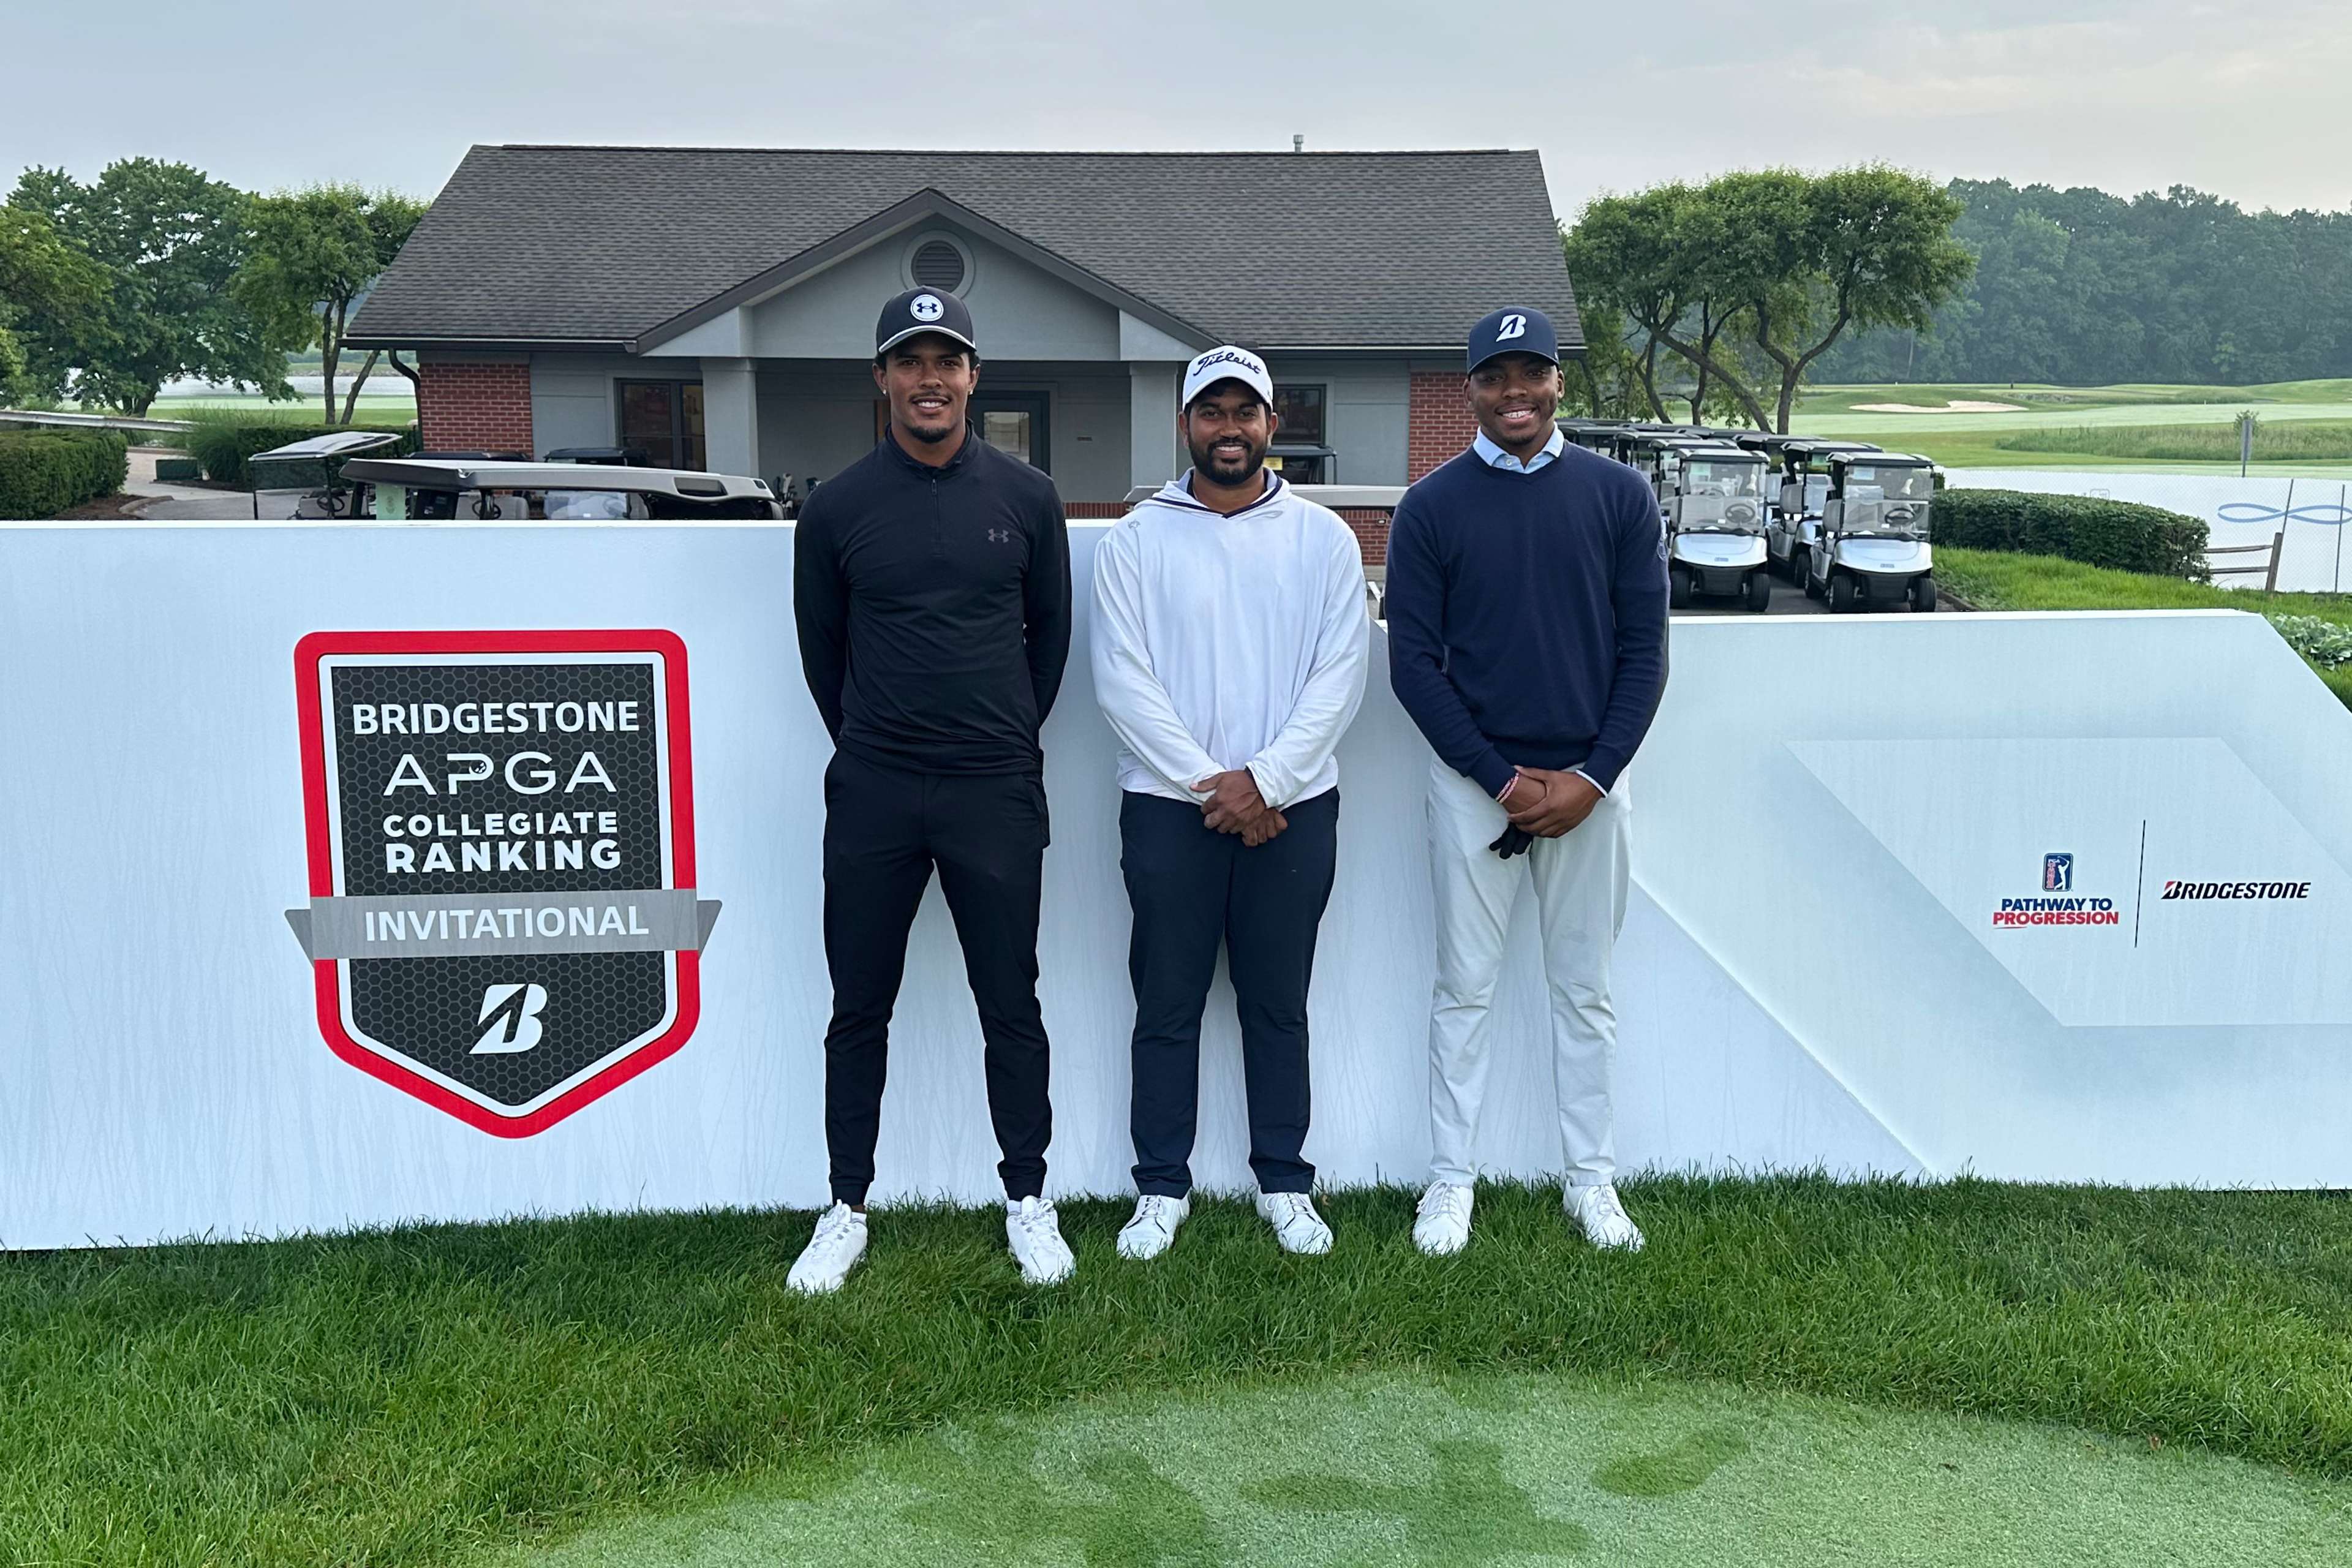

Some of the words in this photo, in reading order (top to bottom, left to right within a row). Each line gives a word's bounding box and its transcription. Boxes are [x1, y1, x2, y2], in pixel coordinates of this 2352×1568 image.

[1193, 351, 1261, 376] Titleist
[353, 701, 639, 734] BRIDGESTONE
[383, 751, 617, 796] APGA
[383, 811, 617, 837] COLLEGIATE
[385, 839, 620, 873] RANKING
[2161, 881, 2311, 899] BRIDGESTONE
[2001, 898, 2087, 911] PATHWAY
[2089, 898, 2113, 911] TO
[365, 905, 649, 941] INVITATIONAL
[1992, 911, 2119, 925] PROGRESSION
